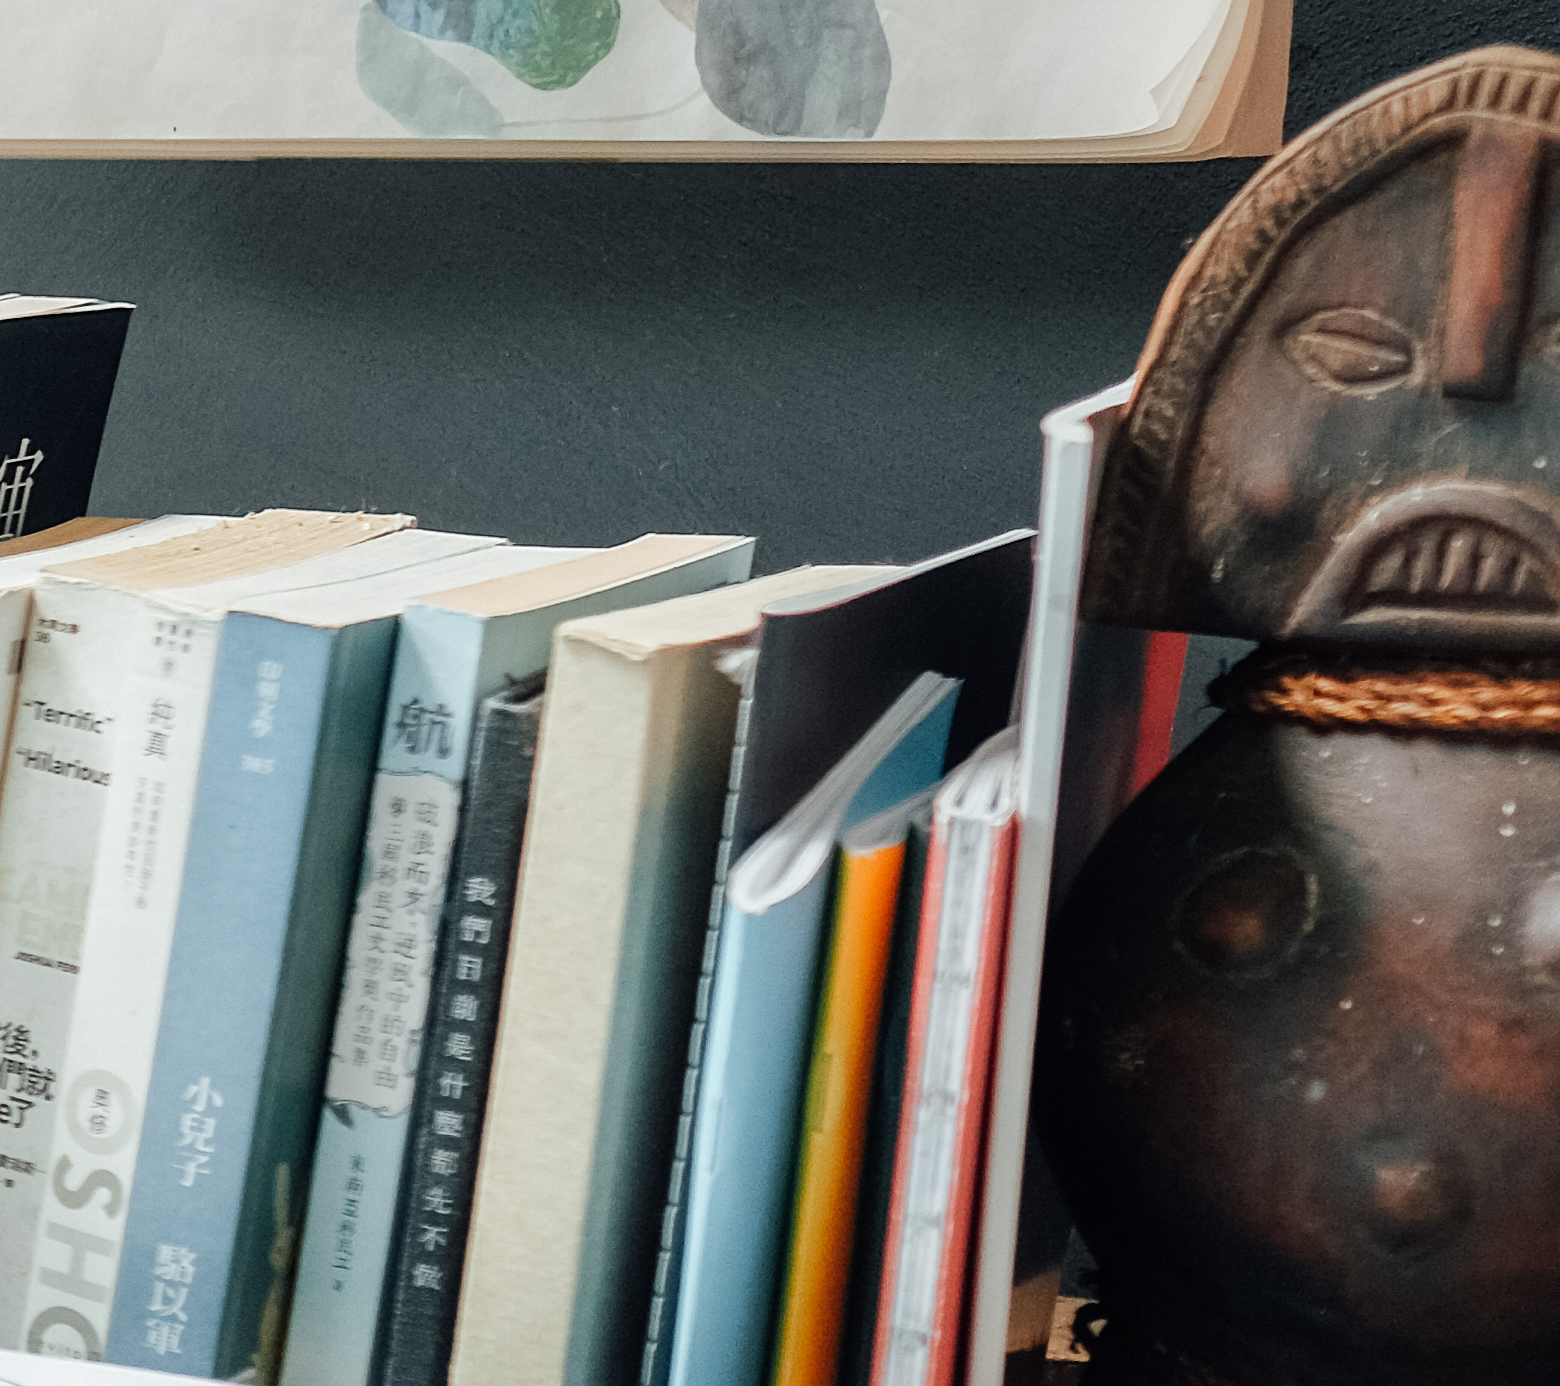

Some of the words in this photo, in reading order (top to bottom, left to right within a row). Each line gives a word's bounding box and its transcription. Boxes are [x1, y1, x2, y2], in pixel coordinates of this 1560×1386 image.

[171, 1076, 224, 1188] 小兒子
[144, 1244, 196, 1356] 駱以軍
